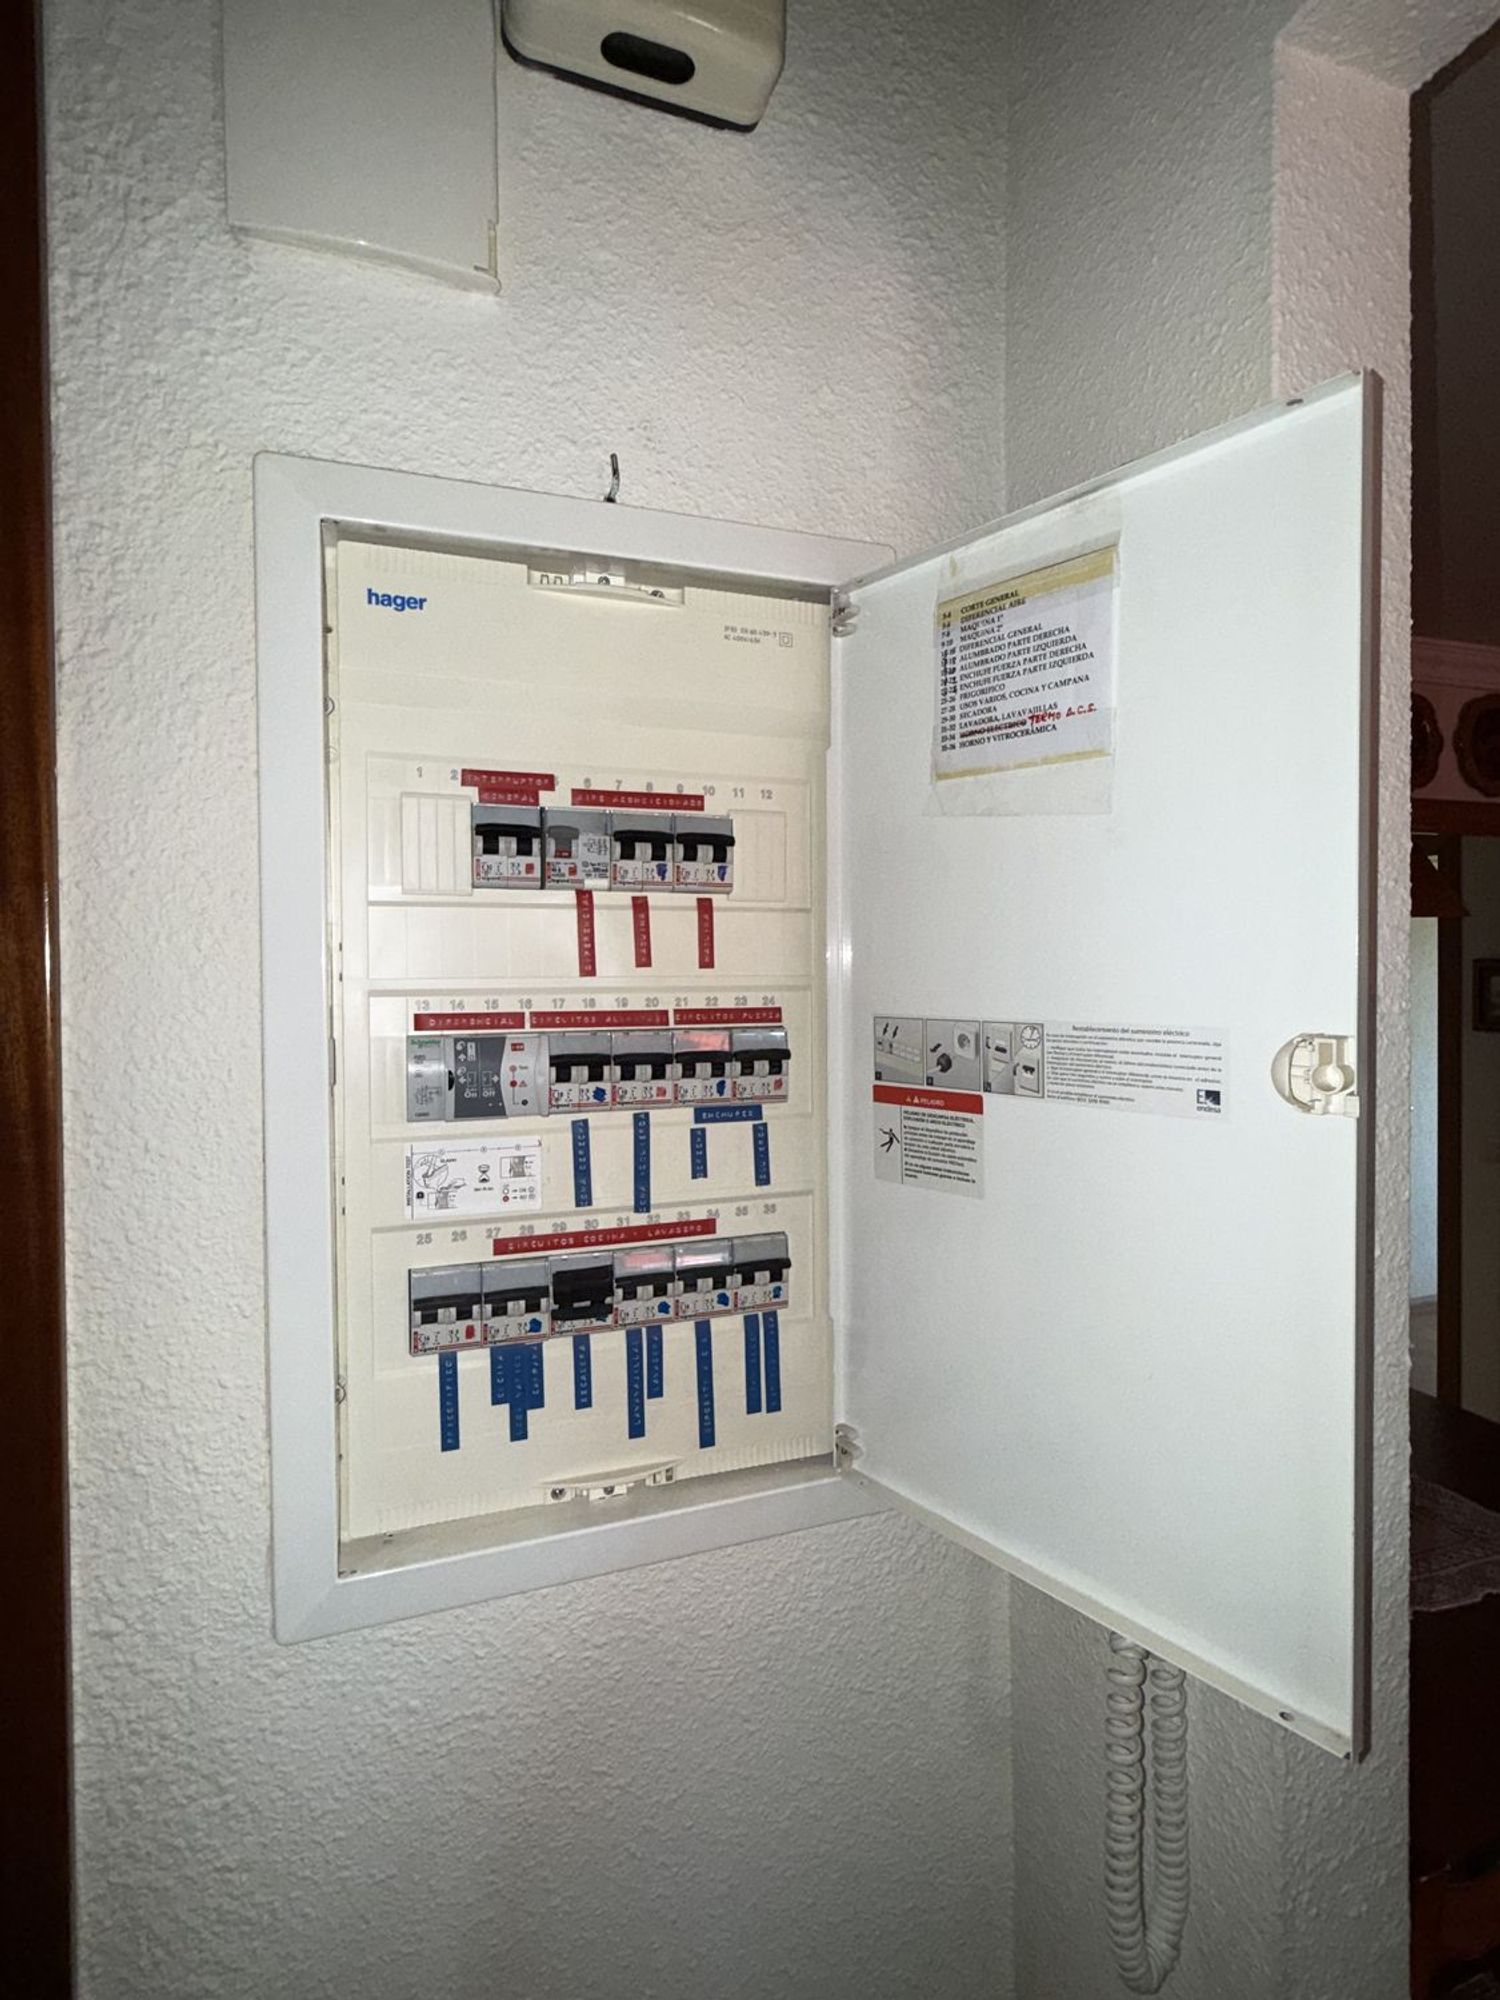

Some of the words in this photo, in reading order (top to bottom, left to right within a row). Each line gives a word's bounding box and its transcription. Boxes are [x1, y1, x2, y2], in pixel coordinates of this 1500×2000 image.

[367, 588, 427, 612] hager
[961, 601, 984, 614] CORTE
[985, 590, 1019, 606] GENERAL
[961, 604, 1006, 623] DIFERENCIAL
[1009, 597, 1026, 610] AIRE
[961, 617, 995, 633] MAQUINA
[960, 633, 1006, 652] DIFERENCIAL
[1007, 623, 1042, 639] GENERAL
[961, 627, 995, 642] MAQUINA
[961, 643, 1006, 661] ALUMBRADO
[1007, 637, 1031, 650] PARTE
[1032, 625, 1070, 642] DERECHA
[961, 653, 1006, 671] ALUMBRADO
[1007, 646, 1031, 660] PARTE
[1033, 634, 1077, 652] IZQUIERDA
[960, 667, 991, 681] ENCHUFE
[993, 660, 1021, 673] FUERZA
[1023, 653, 1047, 666] PARTE
[1049, 642, 1087, 659] DERECHA
[960, 677, 991, 691] ENCHUFE
[993, 670, 1021, 682] FUERZA
[1023, 662, 1047, 675] PARTE
[1049, 651, 1095, 669] IZQUIERDA
[960, 700, 978, 710] USOS
[1009, 685, 1039, 699] COCINA
[1047, 674, 1090, 690] CAMPANA
[960, 706, 997, 719] SECADORA
[1001, 701, 1058, 720] LAVAVAJILLAS
[1028, 711, 1061, 726] TERMO
[960, 738, 985, 749] HORNO
[417, 766, 423, 778] 1
[450, 769, 458, 781] 2
[615, 780, 623, 790] 7
[703, 785, 716, 796] 10
[733, 787, 745, 798] 11
[761, 788, 773, 799] 12
[416, 1000, 430, 1010] 13
[450, 1000, 465, 1010] 14
[484, 999, 499, 1010] 15
[518, 998, 532, 1009] 16
[551, 998, 566, 1009] 17
[582, 998, 596, 1008] 18
[614, 997, 628, 1008] 19
[644, 997, 659, 1008] 20
[675, 997, 688, 1007] 21
[705, 996, 719, 1007] 22
[734, 996, 748, 1007] 23
[762, 995, 775, 1006] 24
[429, 1017, 514, 1026] DIFERENCIAL
[532, 1016, 596, 1025] CIRCUITOS
[675, 1013, 734, 1022] CIRCUITOS
[464, 1090, 477, 1098] On
[482, 1090, 496, 1098] Off
[702, 1110, 753, 1120] ENCHUFES
[1196, 1105, 1221, 1114] endesa
[677, 1211, 690, 1221] 33
[735, 1206, 748, 1217] 35
[616, 1216, 630, 1226] 31
[647, 1213, 660, 1224] 32
[520, 1224, 535, 1235] 28
[552, 1222, 567, 1232] 29
[585, 1219, 599, 1230] 30
[451, 1230, 467, 1242] 26
[485, 1227, 501, 1239] 27
[508, 1238, 574, 1250] CIRCUITOS
[583, 1233, 625, 1244] COCINA
[647, 1224, 702, 1237] LAVADERO
[416, 1233, 433, 1245] 25
